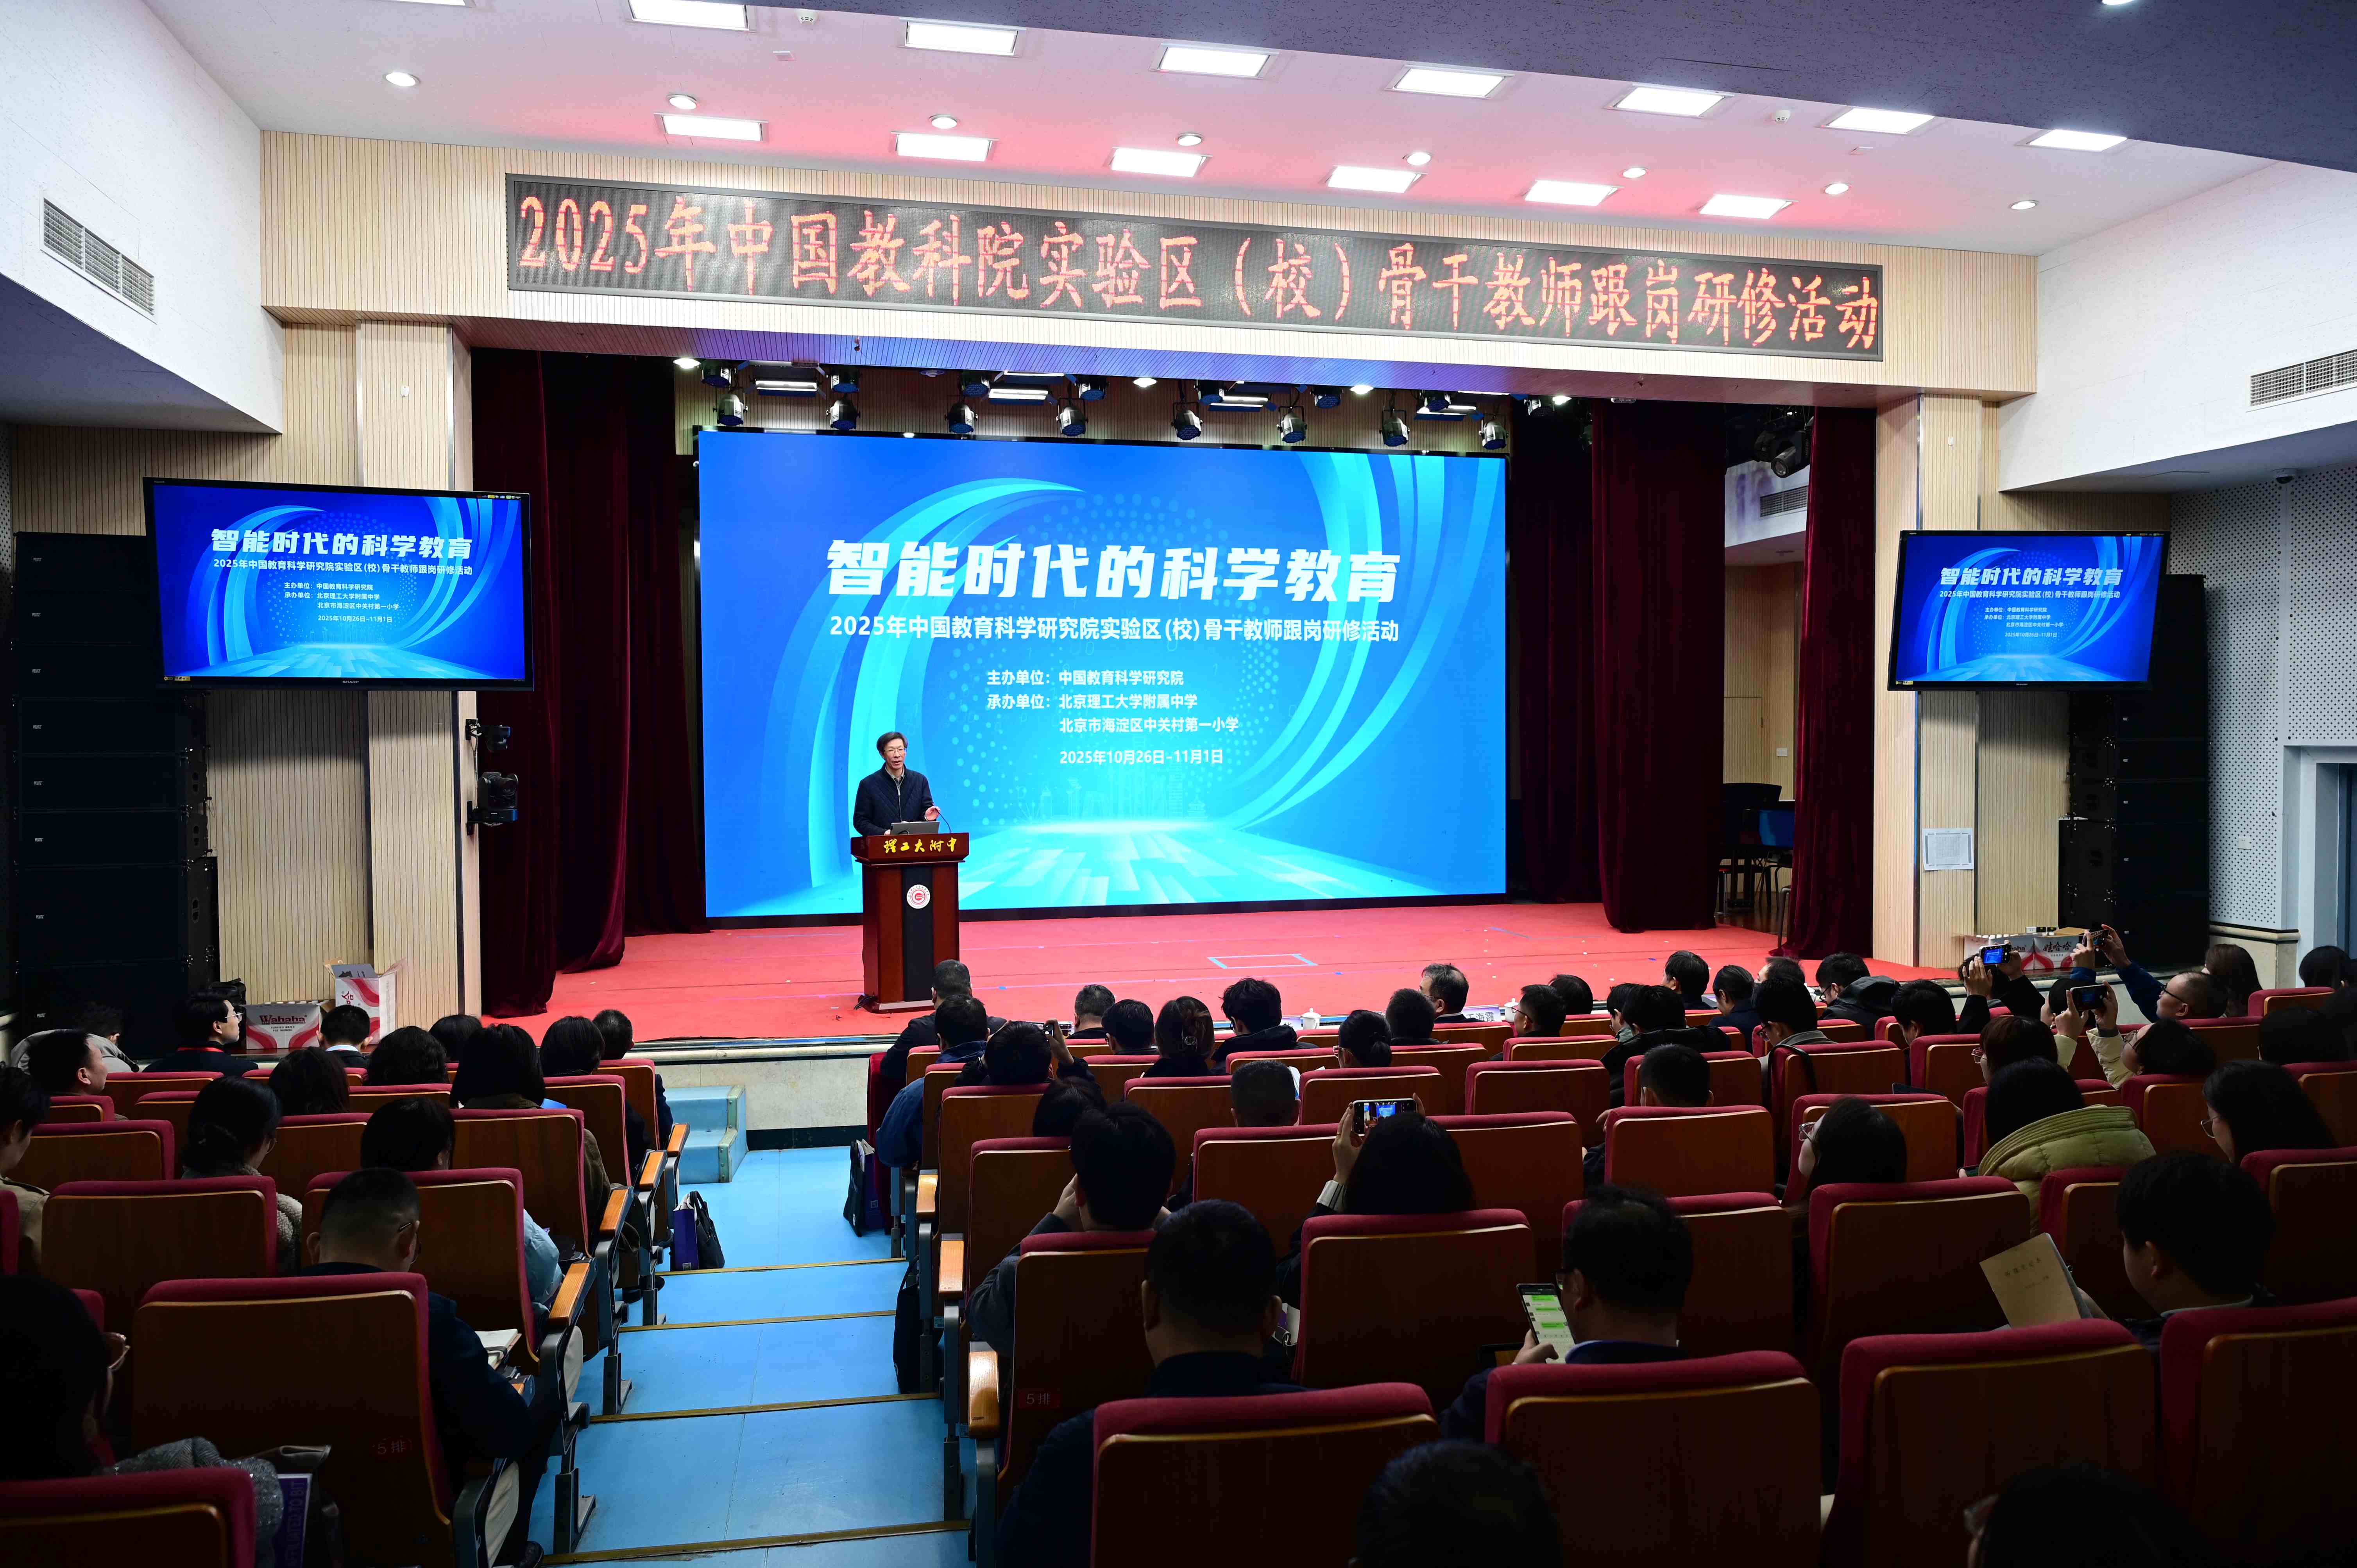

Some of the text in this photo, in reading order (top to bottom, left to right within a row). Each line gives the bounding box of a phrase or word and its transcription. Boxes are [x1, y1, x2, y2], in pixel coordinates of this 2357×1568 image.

[212, 528, 472, 559] 智能时代的科学教育
[827, 539, 1401, 603] 智能时代的科学教育
[1940, 567, 2123, 585] 智能时代的科学教育
[1059, 717, 1239, 733] 北京市海淀区中关村第一小学
[1059, 749, 1223, 766] 2025年10月26日-11月1日
[883, 837, 957, 853] 理工大附中
[2043, 941, 2071, 952] 娃哈哈
[259, 1015, 305, 1024] Wahaha
[1026, 1392, 1051, 1406] 5排
